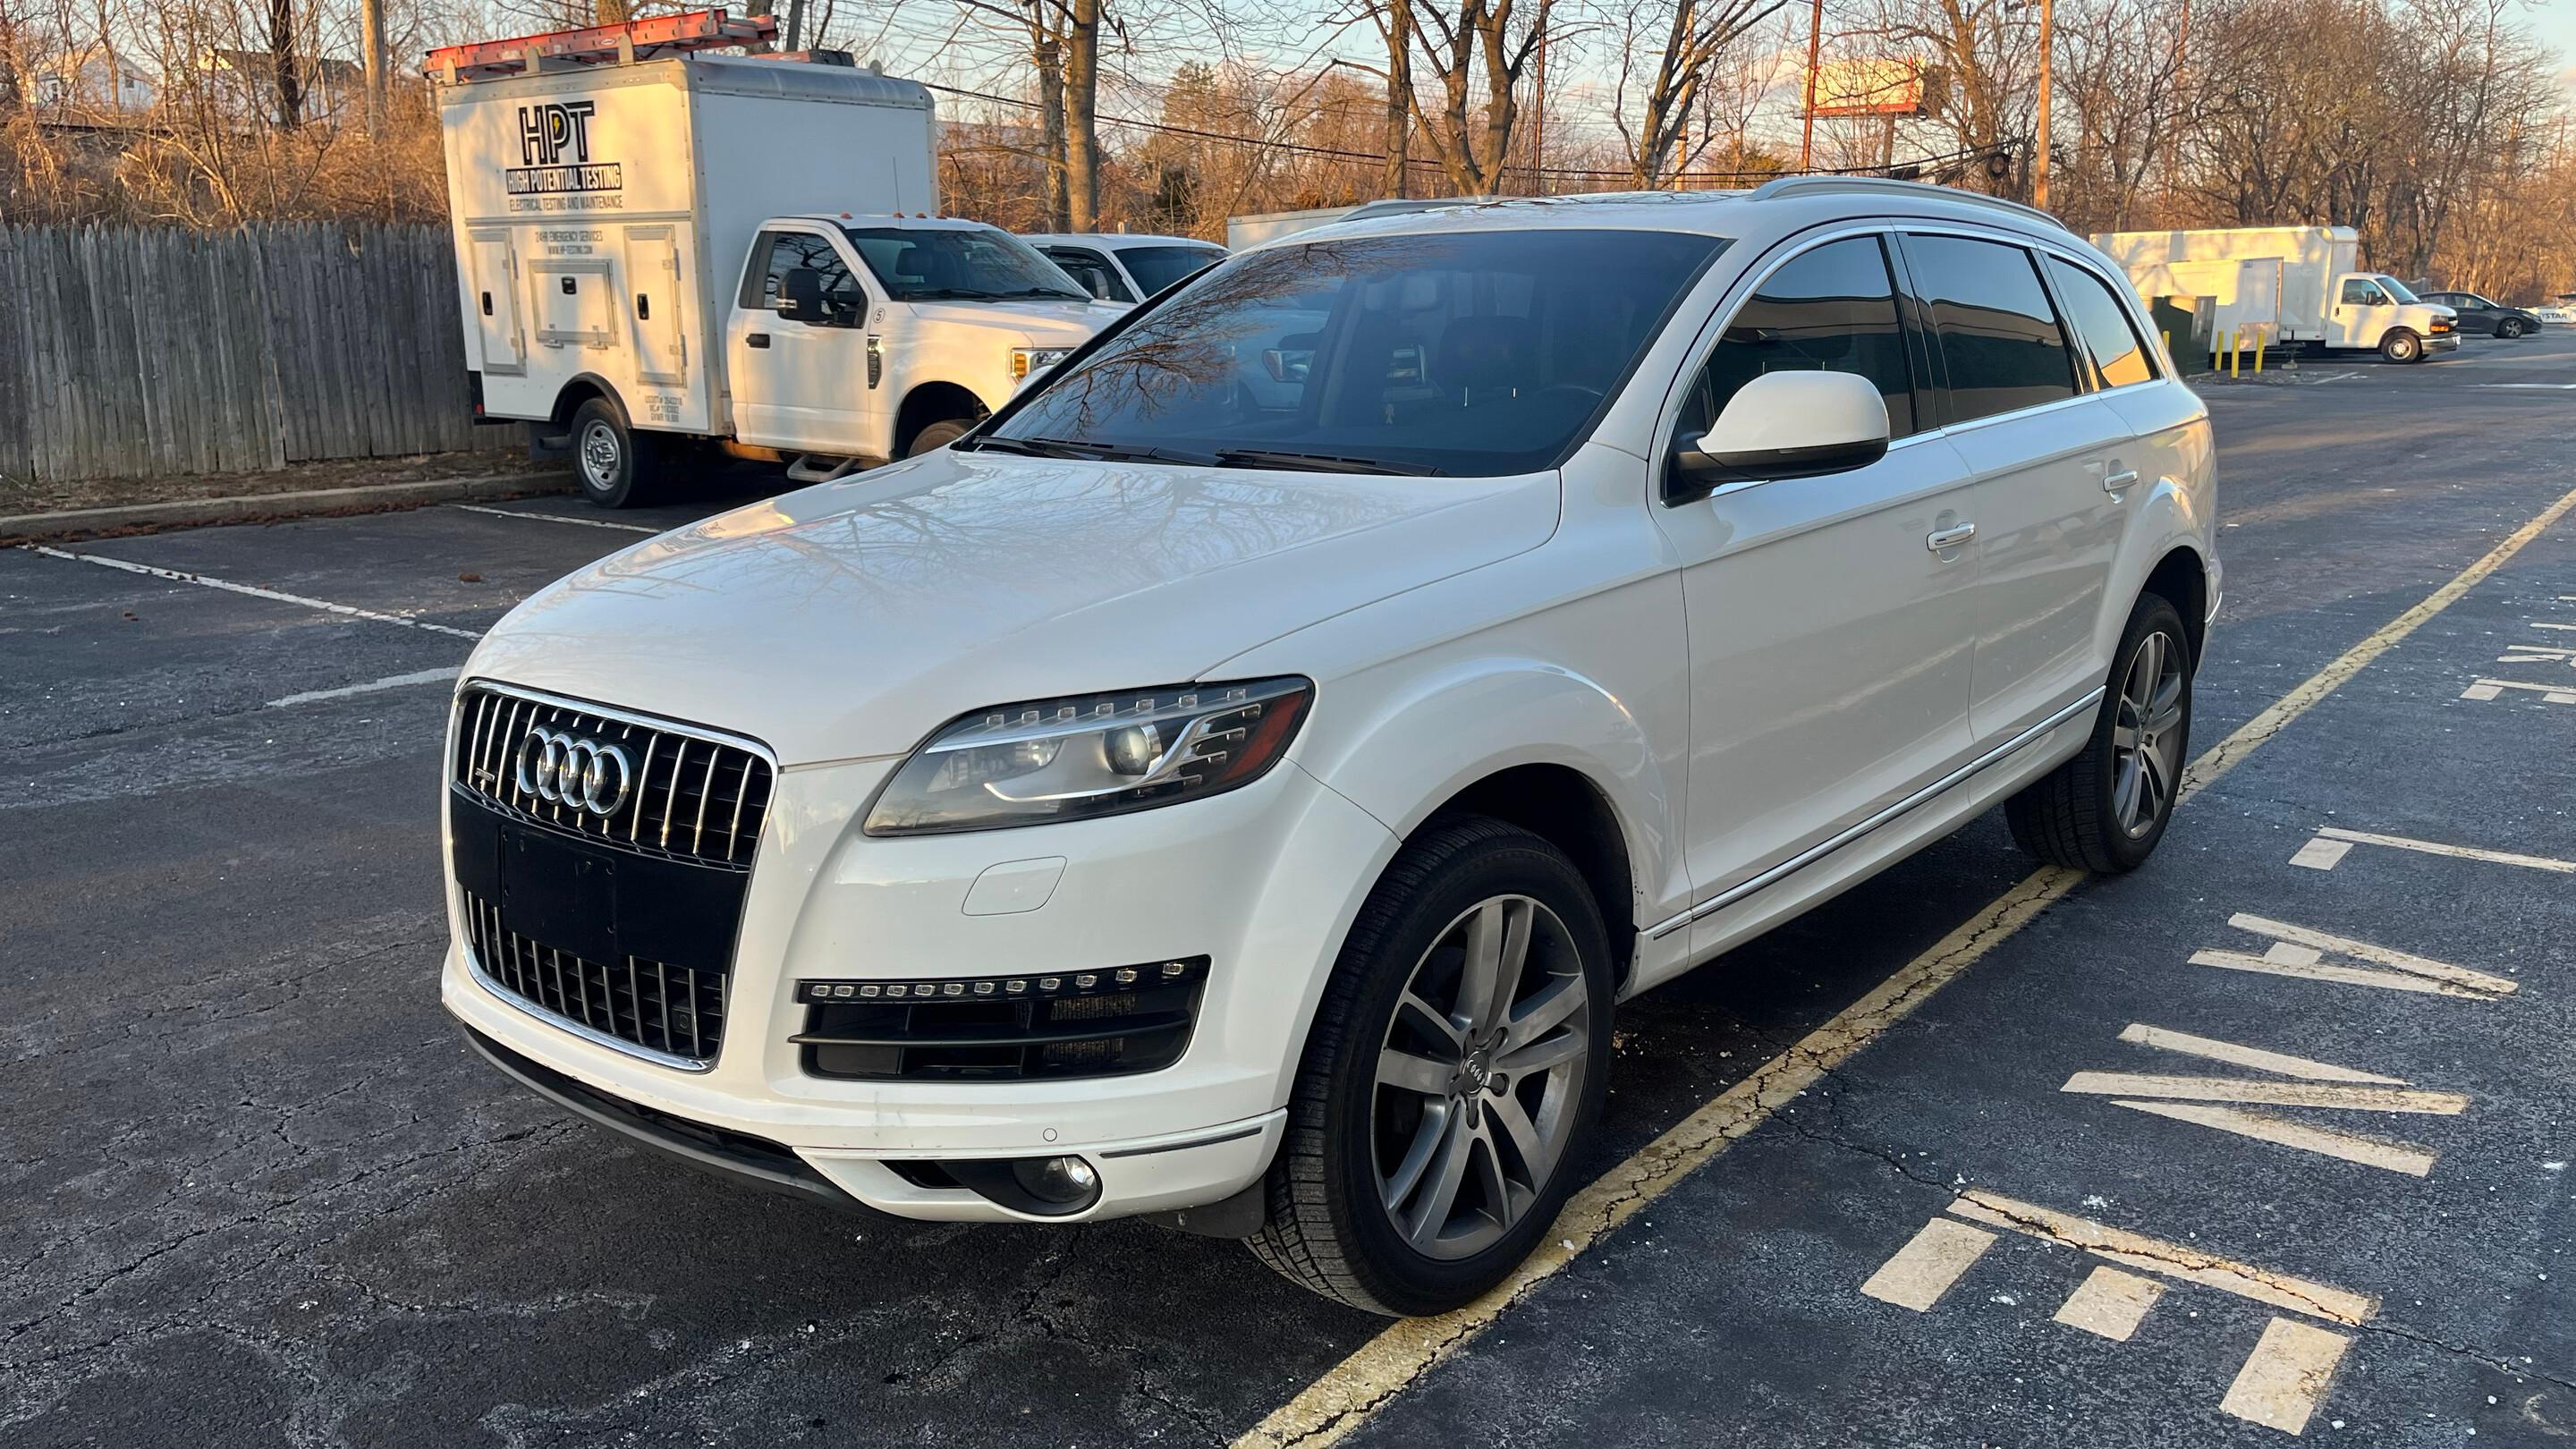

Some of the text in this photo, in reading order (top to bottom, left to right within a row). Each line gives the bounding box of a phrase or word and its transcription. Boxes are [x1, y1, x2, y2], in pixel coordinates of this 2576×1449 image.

[518, 100, 596, 165] HPT
[508, 165, 621, 192] HIGH POTENTIAL TESTING
[510, 195, 623, 212] ELECTRICAL TESTING AND MAINTENANCE
[1860, 826, 2576, 1436] LANE
